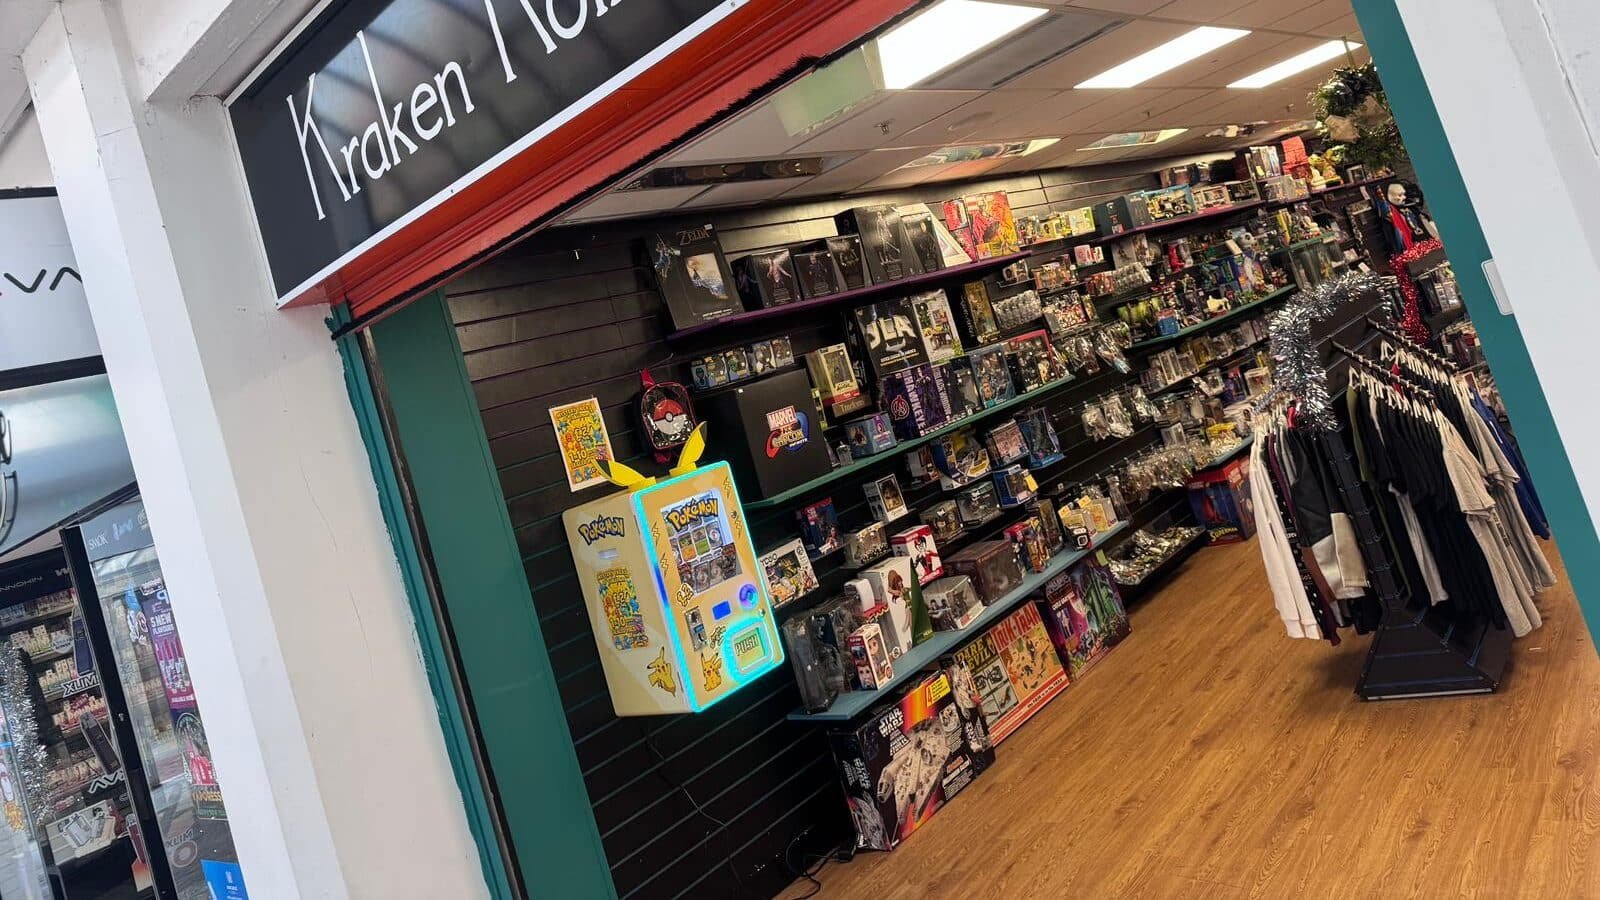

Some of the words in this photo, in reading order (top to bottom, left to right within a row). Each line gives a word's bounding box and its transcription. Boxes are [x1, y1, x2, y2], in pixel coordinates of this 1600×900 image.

[286, 29, 475, 221] Kraken
[677, 229, 710, 246] ZELDA
[867, 313, 917, 350] JLA
[904, 375, 926, 429] HAWKEYE
[767, 406, 796, 430] MARVEL
[157, 611, 172, 626] NEW
[734, 634, 759, 656] PUSH
[957, 640, 985, 663] DARE
[66, 673, 99, 696] XLIM
[880, 708, 902, 727] STAR
